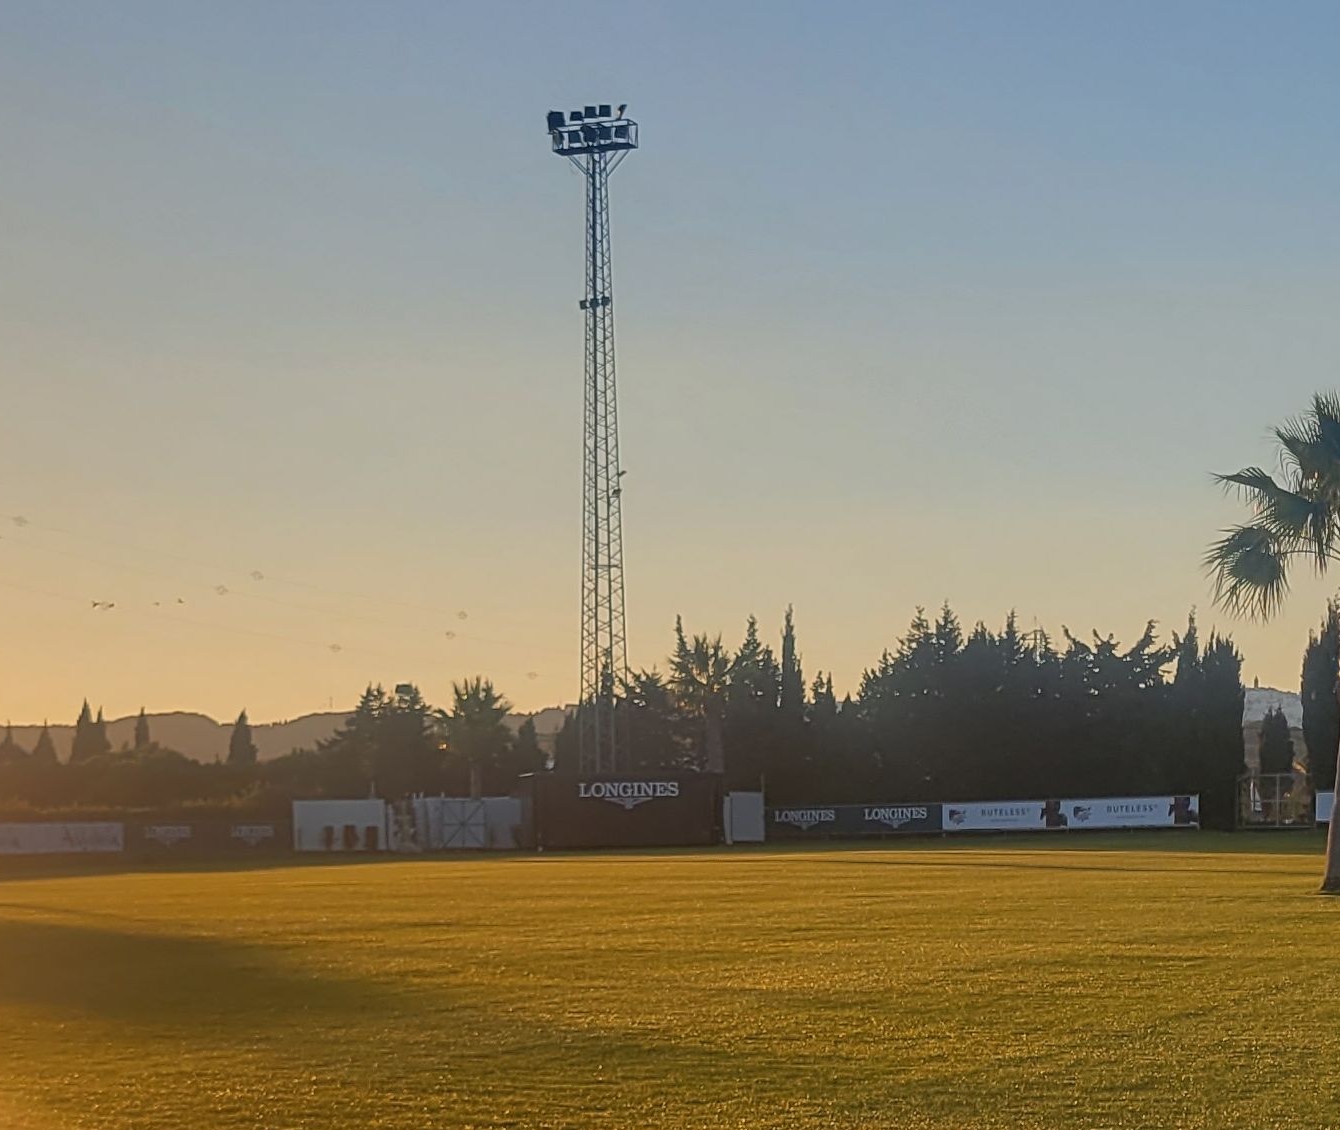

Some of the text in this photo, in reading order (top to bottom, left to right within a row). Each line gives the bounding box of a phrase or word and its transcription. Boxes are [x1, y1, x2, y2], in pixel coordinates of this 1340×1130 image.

[578, 781, 680, 798] LONGINES
[774, 809, 836, 823] LONGINES
[864, 806, 928, 821] LONGINES
